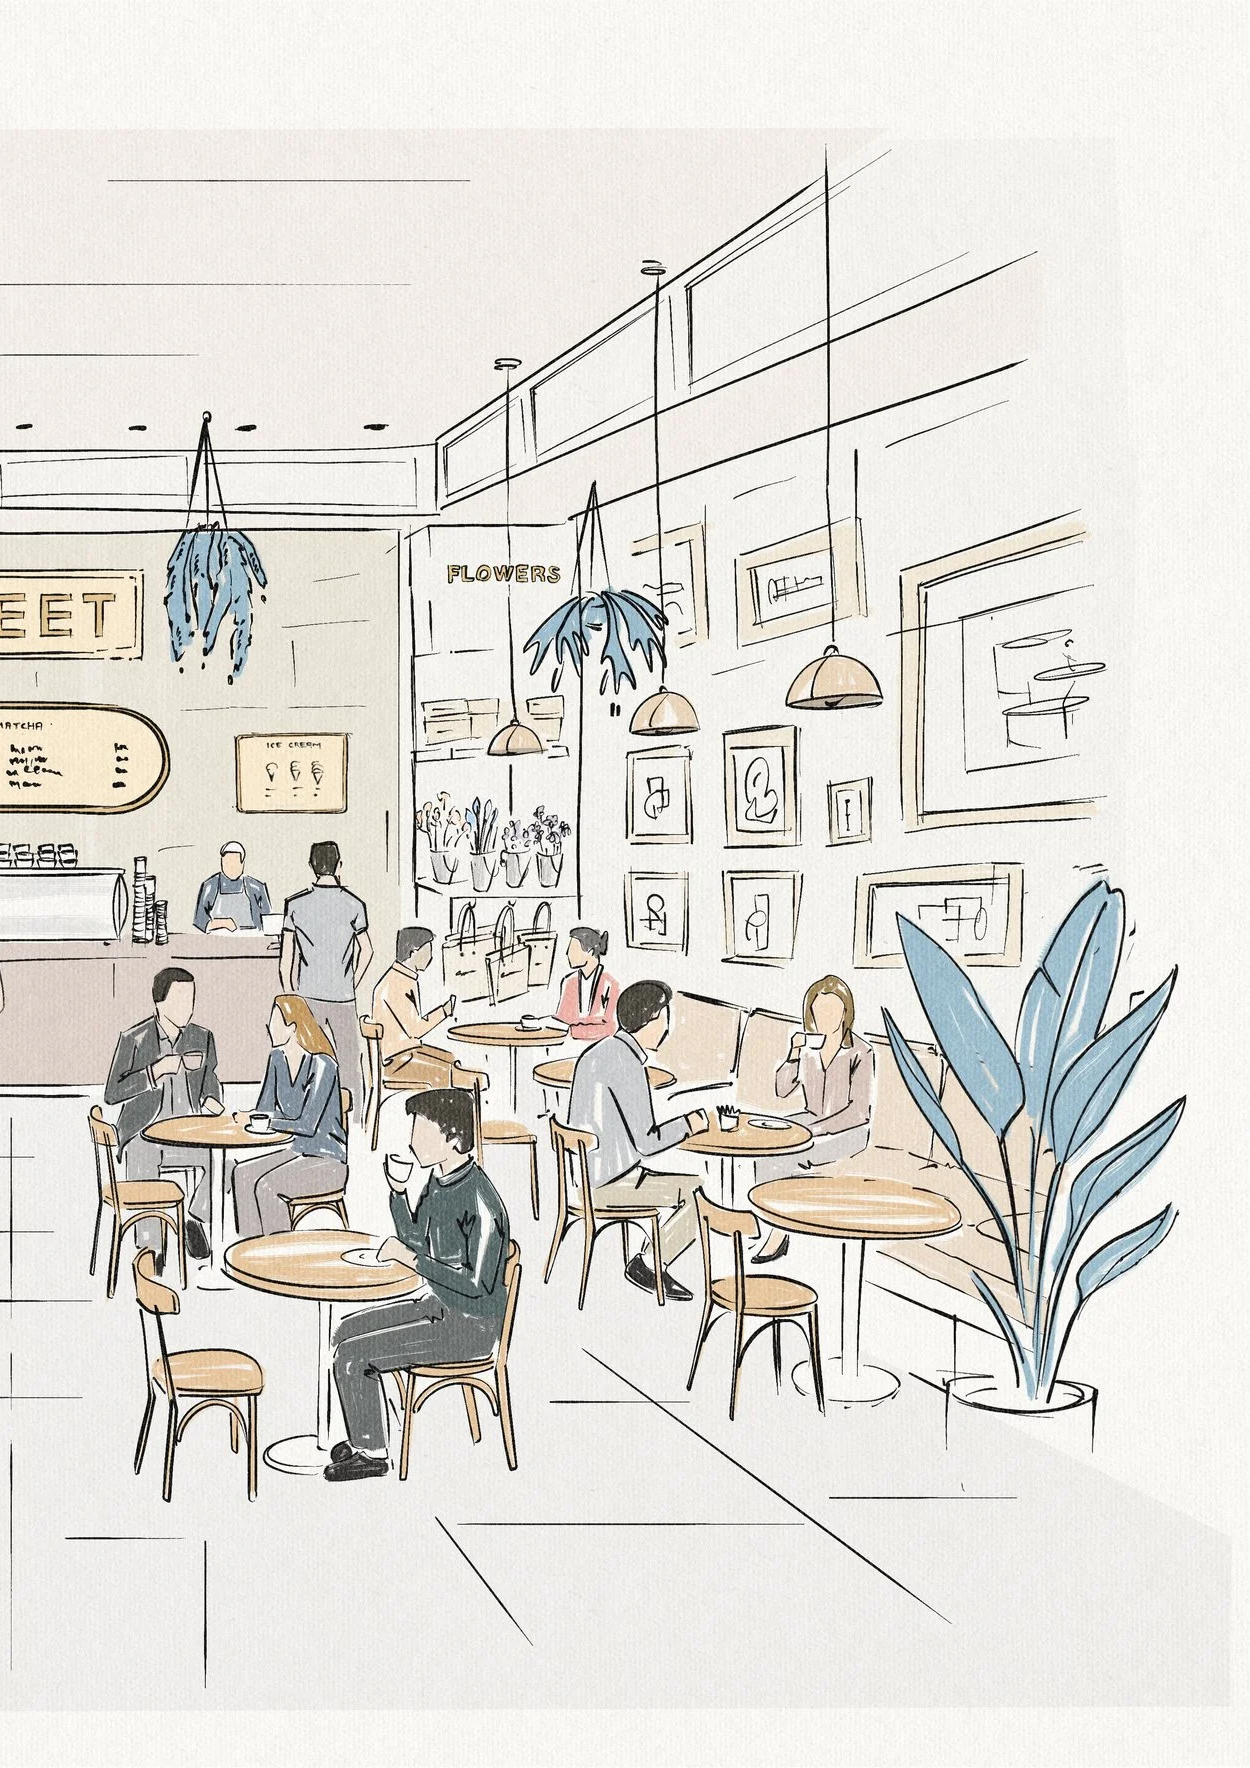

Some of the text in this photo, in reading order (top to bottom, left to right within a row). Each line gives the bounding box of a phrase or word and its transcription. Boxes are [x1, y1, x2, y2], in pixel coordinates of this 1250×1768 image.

[447, 564, 561, 584] FLOWERS
[266, 741, 322, 749] ICE CREAM
